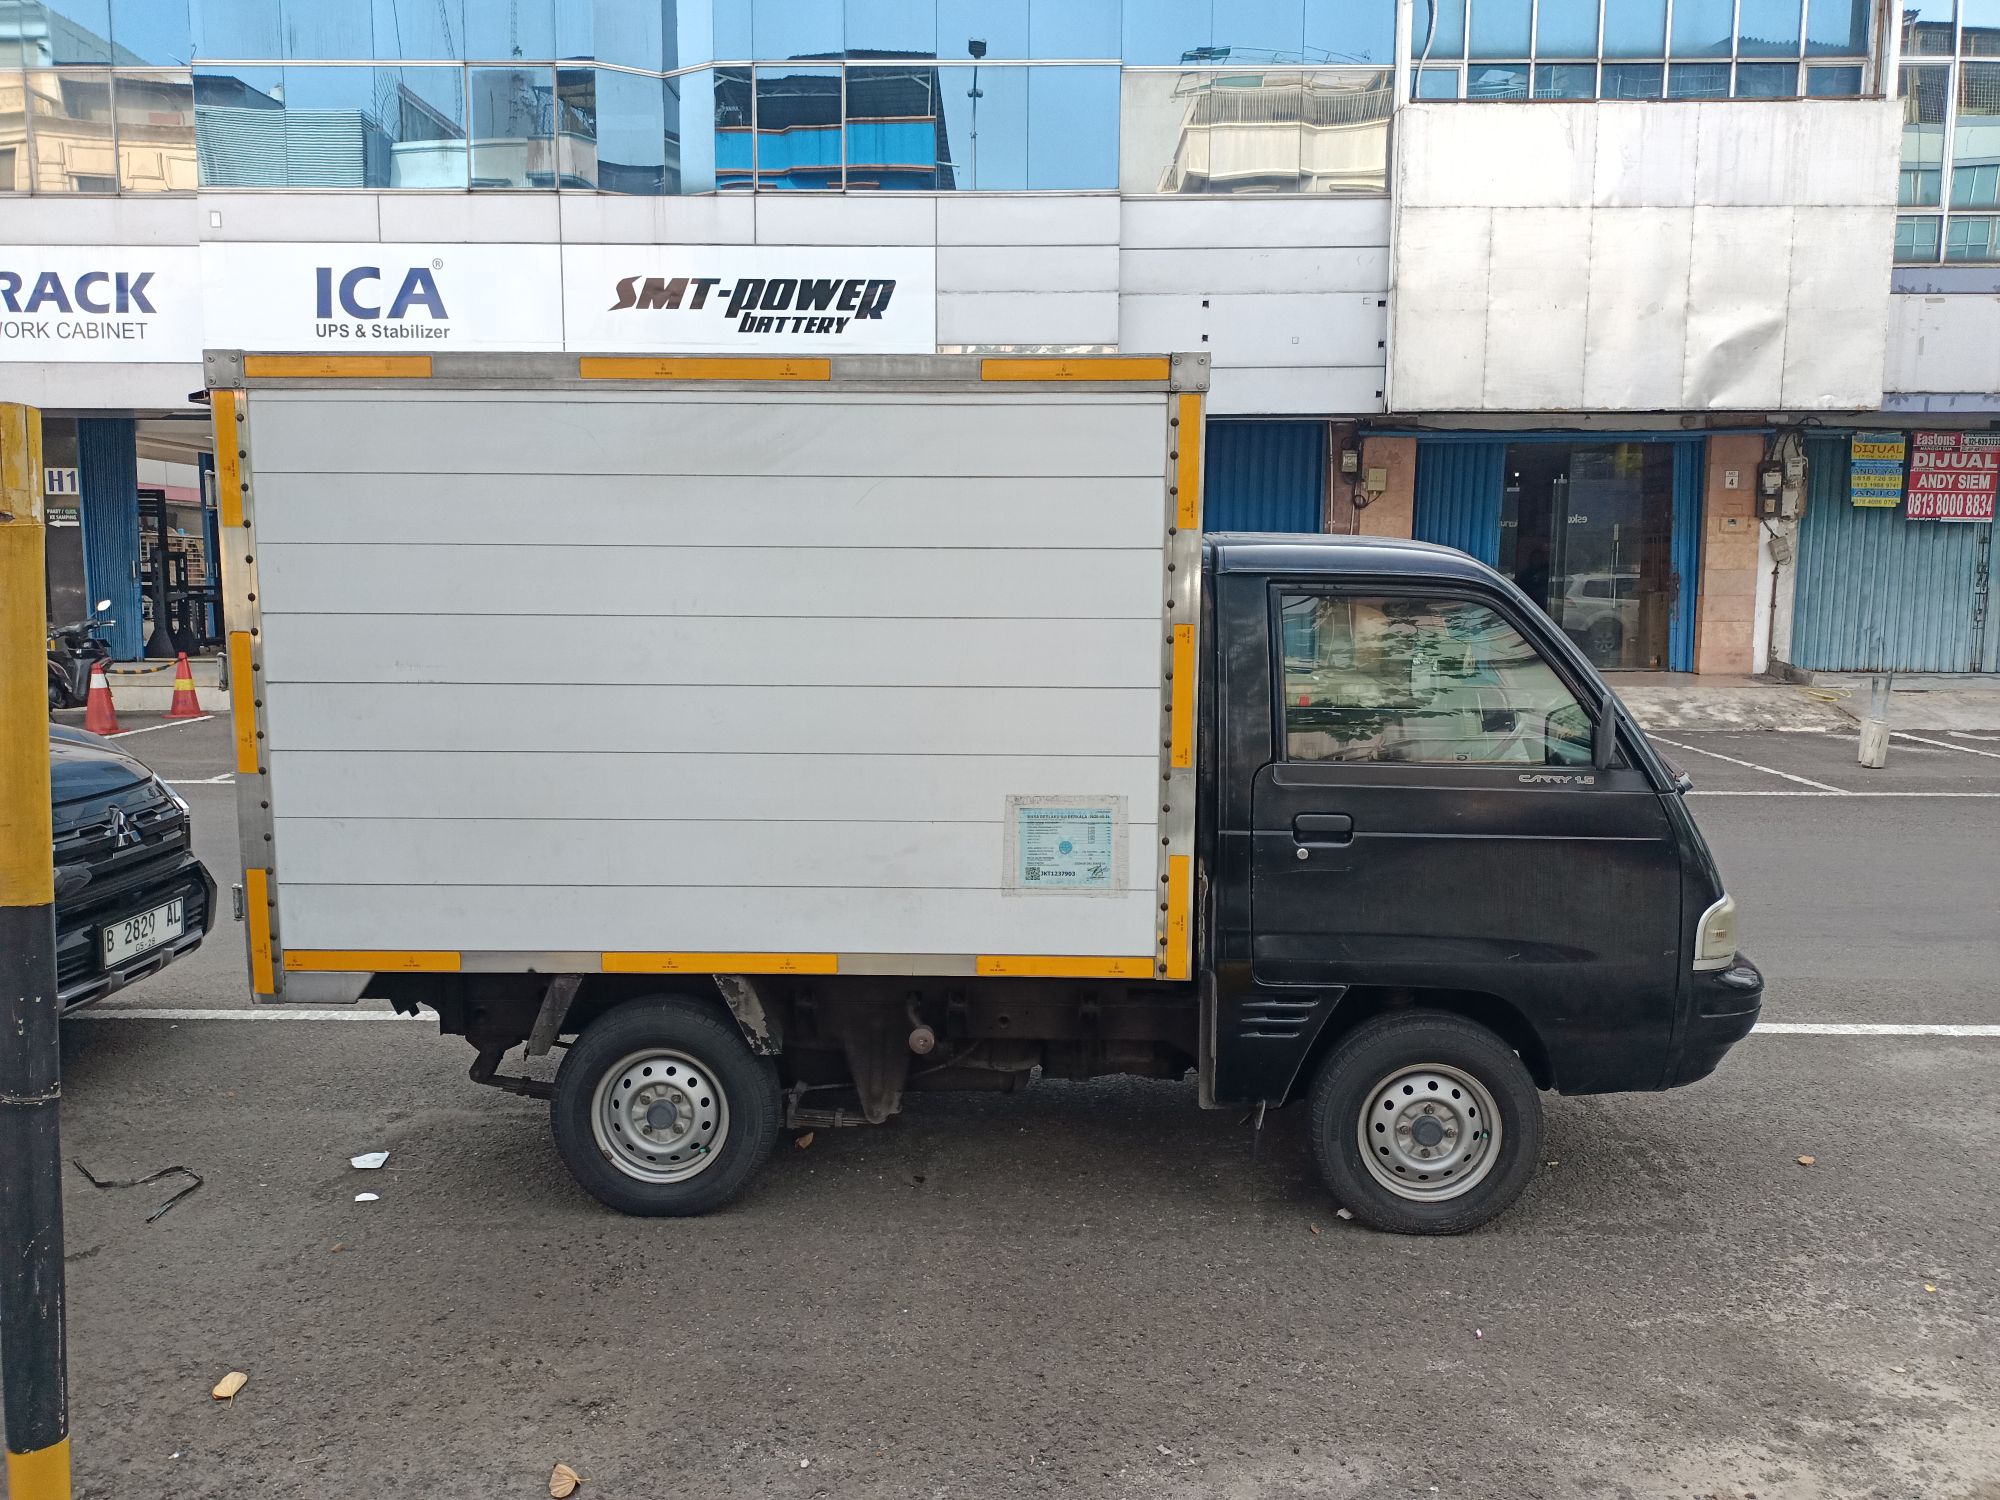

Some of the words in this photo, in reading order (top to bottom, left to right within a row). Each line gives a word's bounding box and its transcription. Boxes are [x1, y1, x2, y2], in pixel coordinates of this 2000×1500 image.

[316, 266, 449, 320] ICA
[607, 275, 896, 319] SMT-POWER
[0, 322, 50, 339] ORK
[56, 322, 148, 339] CABINET
[738, 312, 850, 333] BATTERY
[316, 323, 349, 338] UPS
[355, 323, 366, 338] &
[371, 323, 450, 339] Stabilizer
[1916, 433, 1956, 446] Eastons
[1853, 444, 1903, 453] DIJUAL
[1912, 452, 1998, 468] DIJUAL
[48, 470, 76, 492] H1
[1729, 478, 1735, 486] 4
[1917, 473, 1956, 489] ANDY
[1958, 474, 1991, 489] SIEM
[1908, 493, 1934, 515] 0813
[1936, 493, 1963, 516] 8000
[1965, 494, 1993, 516] 8834
[1518, 774, 1573, 784] CARRY
[106, 929, 114, 952] B
[167, 902, 180, 926] AL
